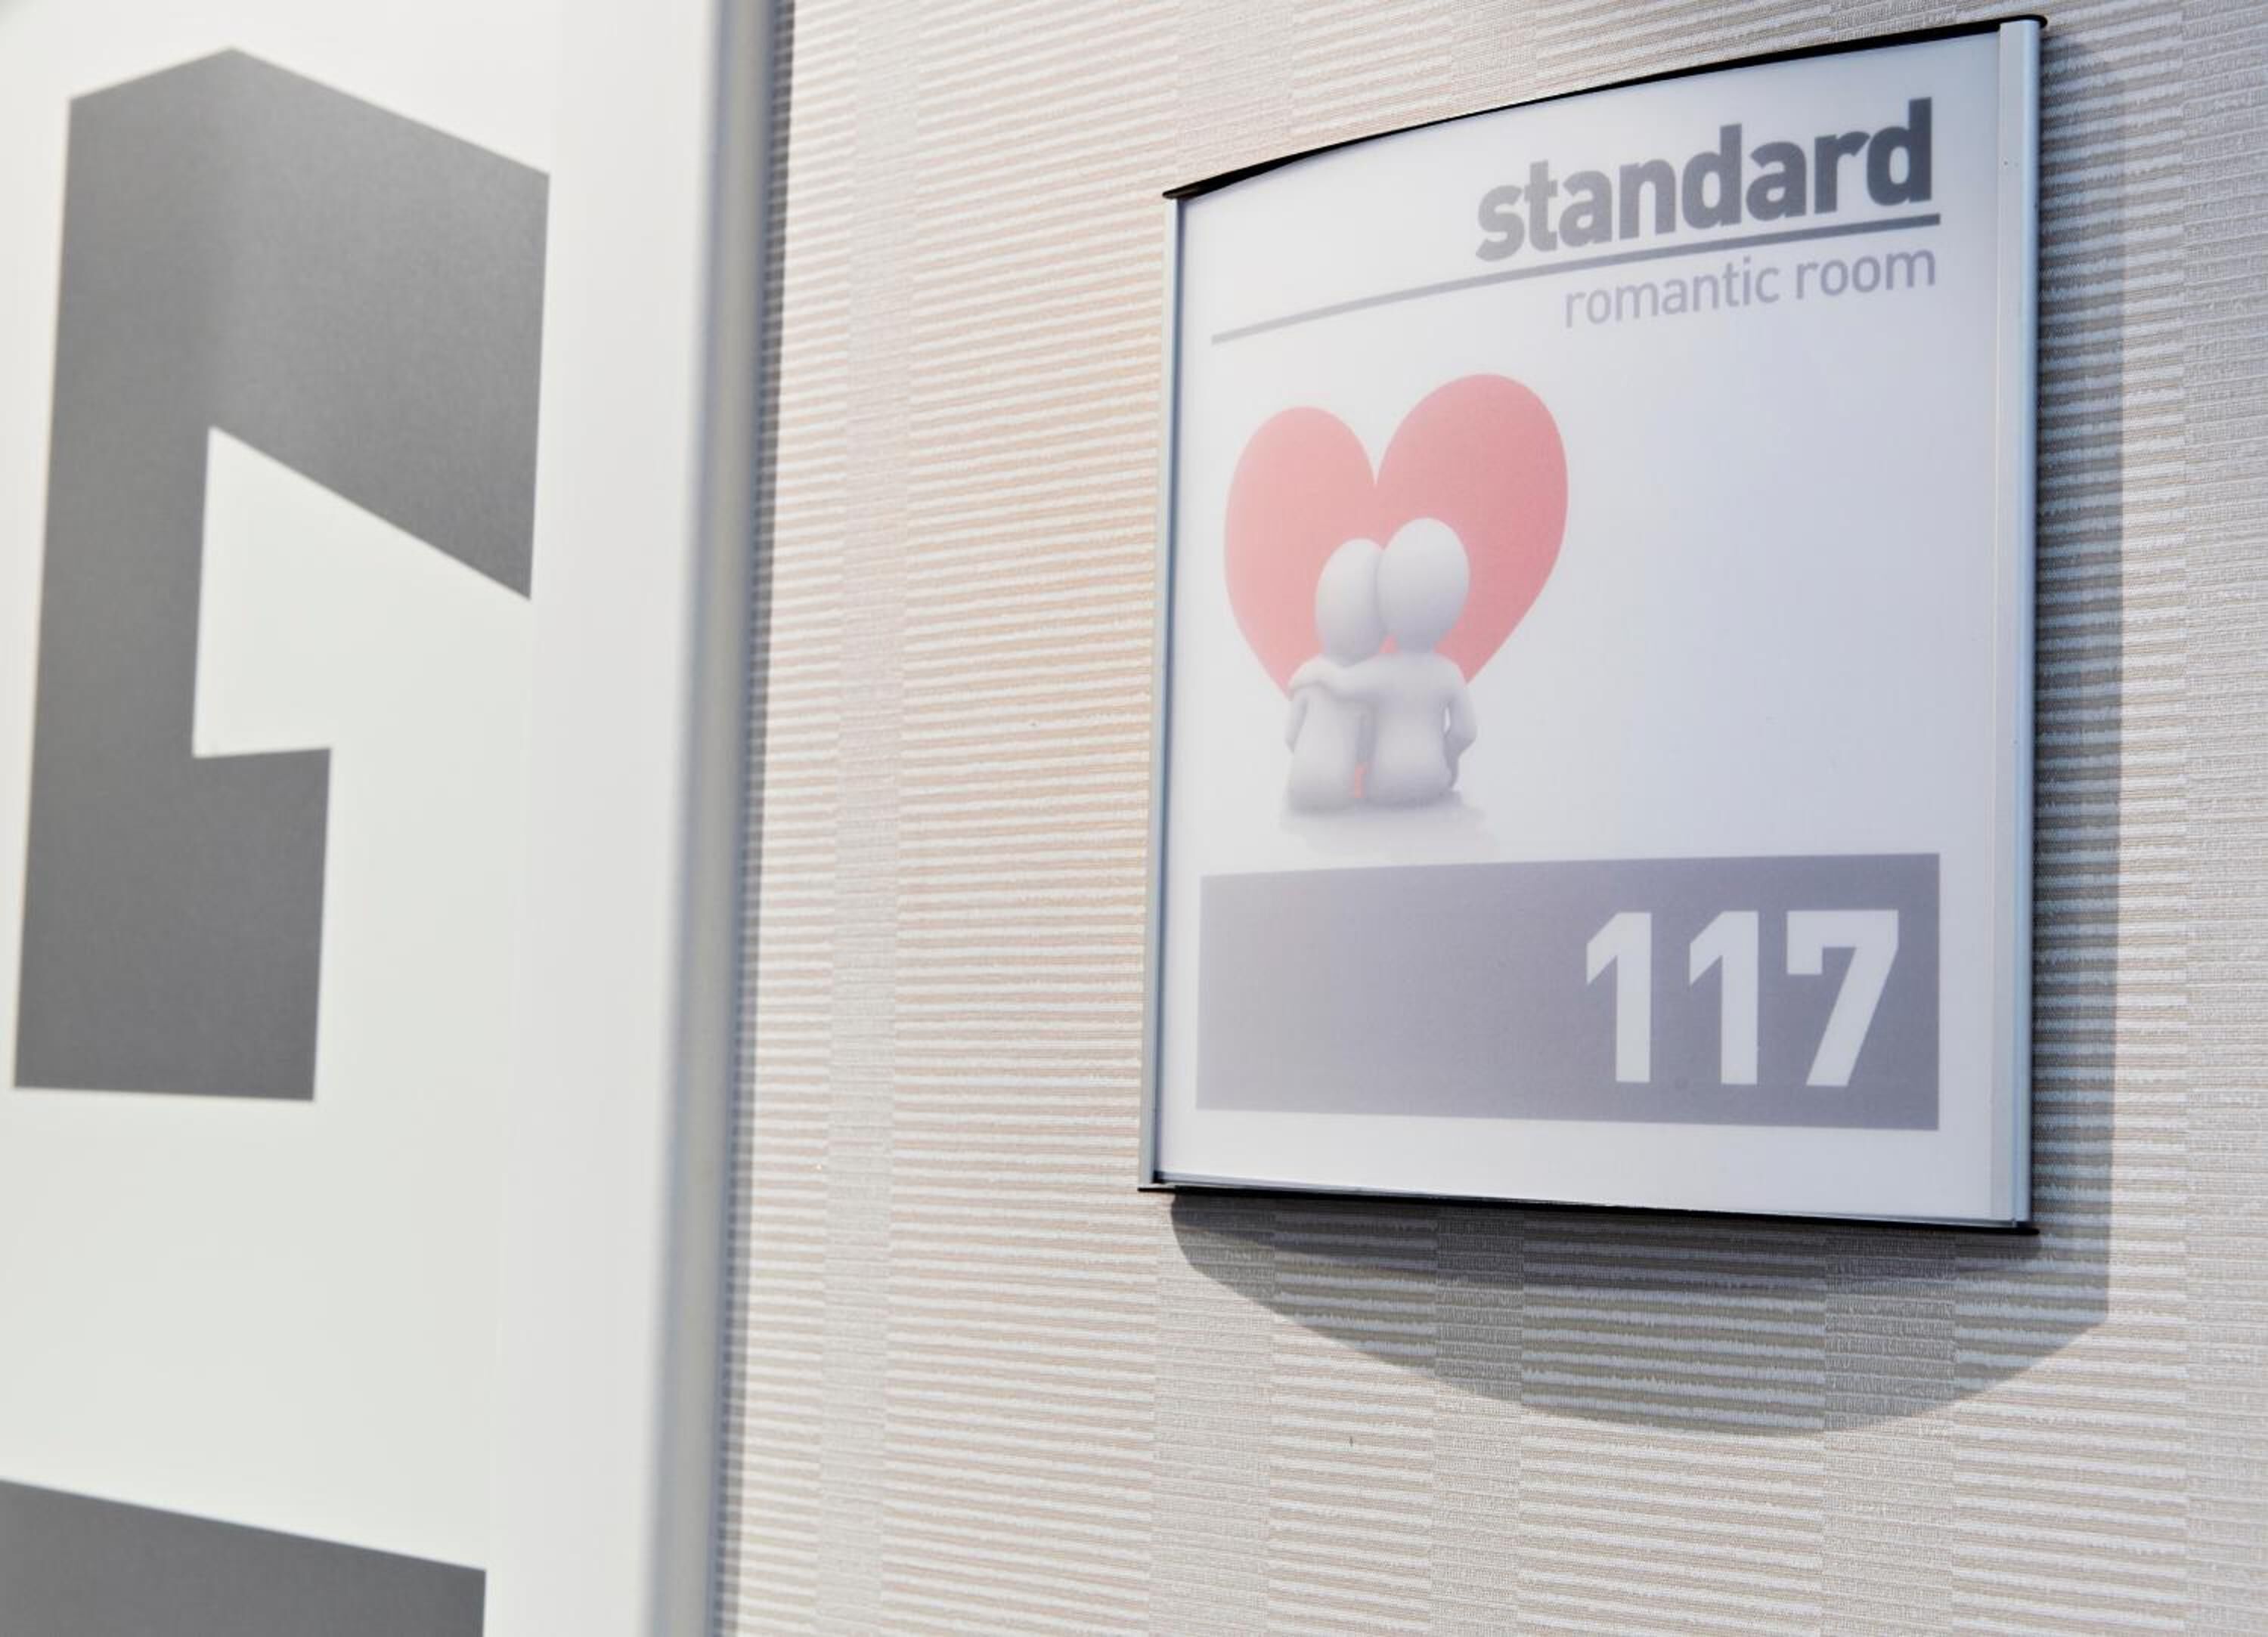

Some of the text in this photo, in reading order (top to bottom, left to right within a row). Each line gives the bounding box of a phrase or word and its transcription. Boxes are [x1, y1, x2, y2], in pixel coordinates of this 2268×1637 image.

[1476, 97, 1932, 262] standard
[1565, 249, 1935, 328] romantic room
[1587, 909, 1899, 1087] 117
